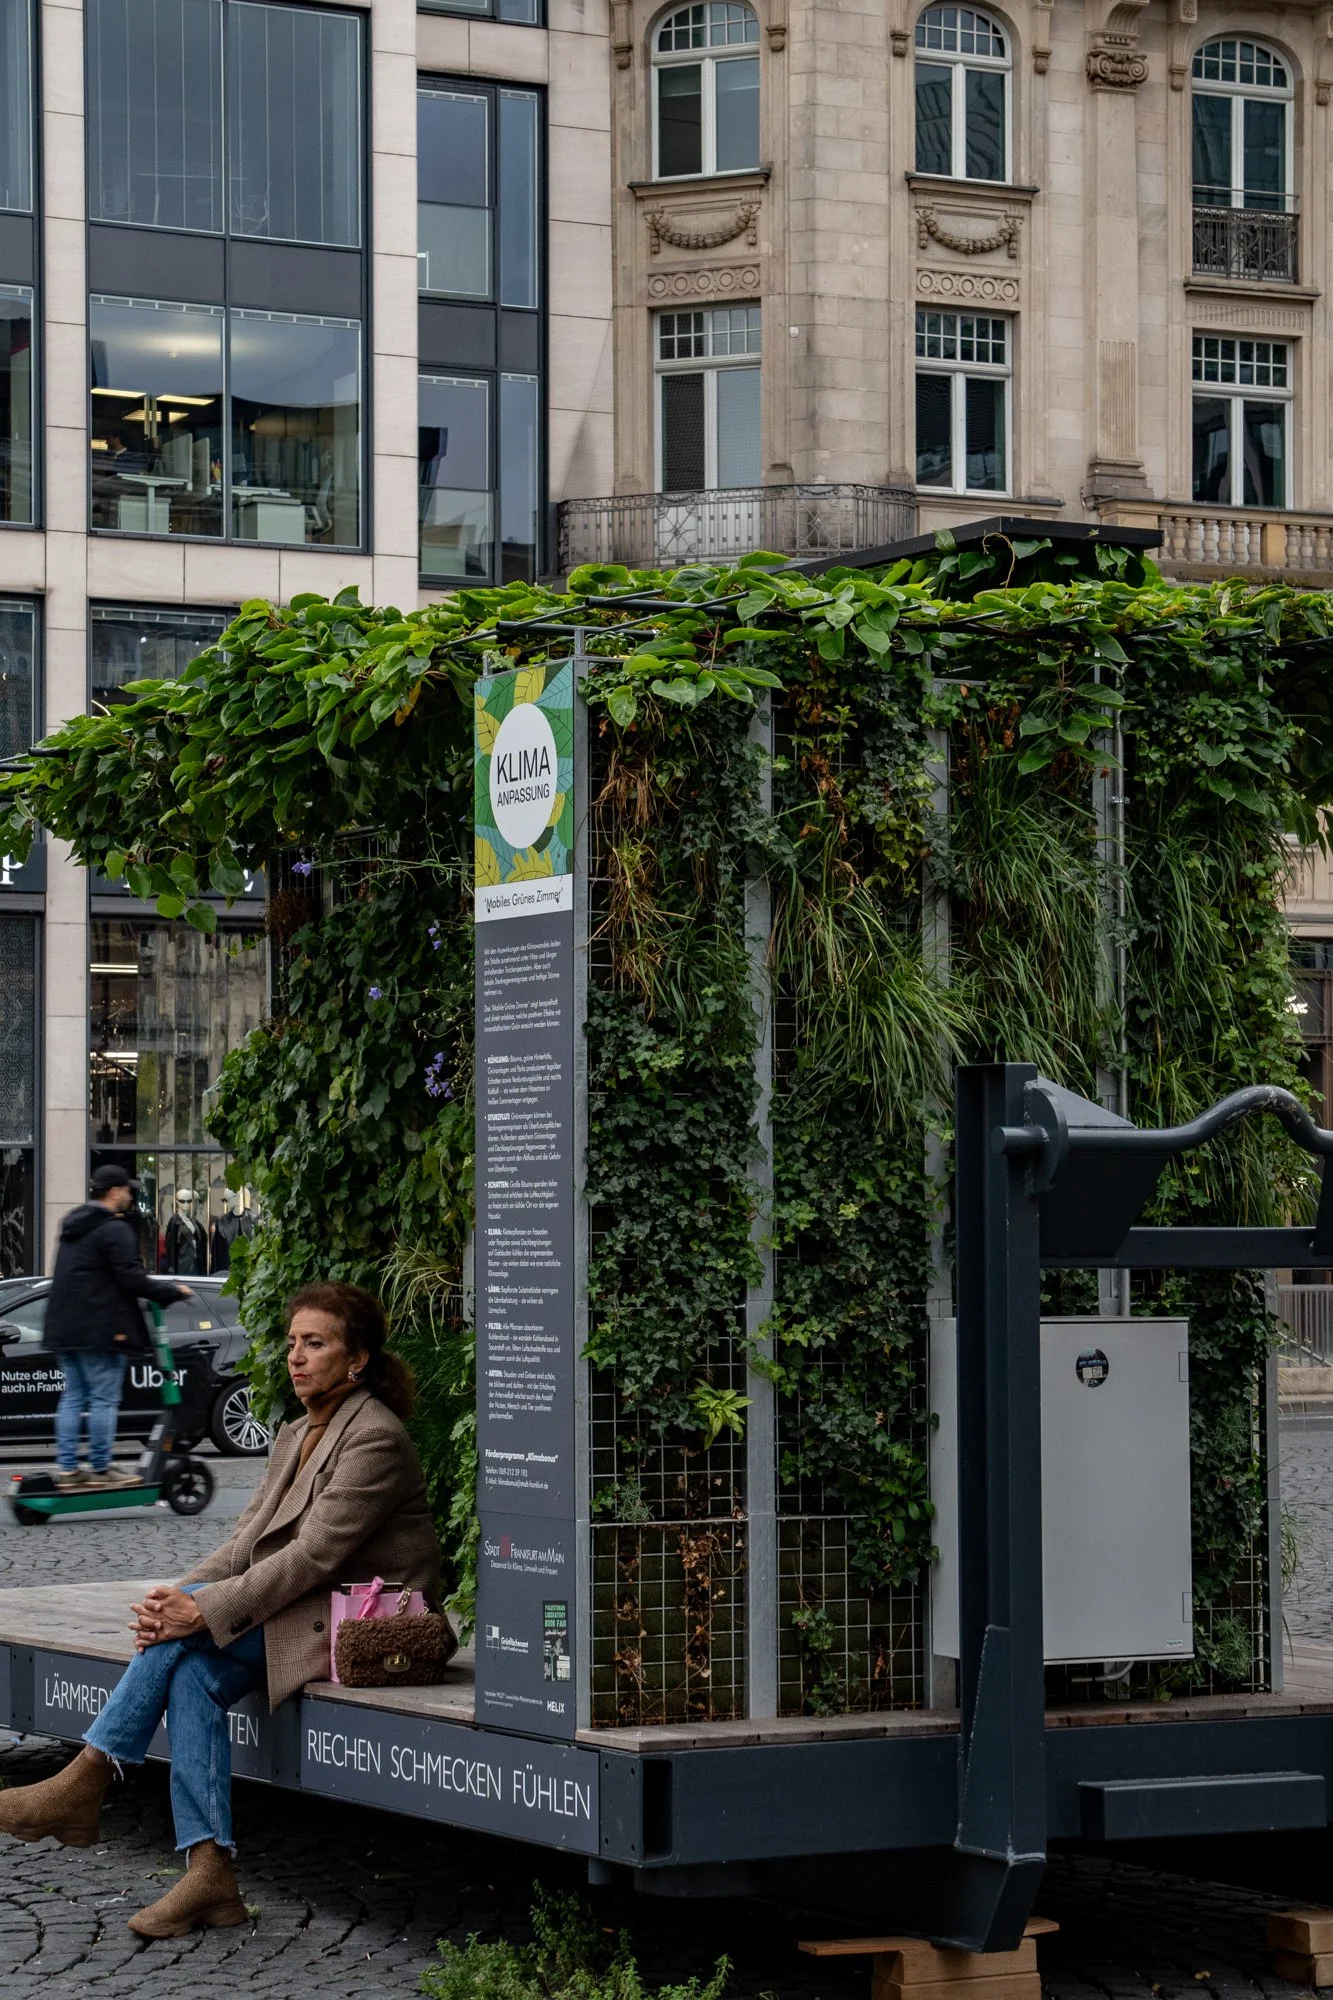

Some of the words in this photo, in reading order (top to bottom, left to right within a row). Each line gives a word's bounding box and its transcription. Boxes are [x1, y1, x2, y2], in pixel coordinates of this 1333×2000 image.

[497, 745, 551, 785] KLIMA
[497, 783, 550, 807] ANPASSUNG
[511, 889, 536, 906] Grünes
[1, 1370, 30, 1381] Nutze
[32, 1369, 48, 1380] die
[1, 1383, 25, 1393] auch
[27, 1382, 36, 1392] in
[37, 1381, 67, 1392] Frankf
[485, 1449, 524, 1461] Förderprogramm
[45, 1672, 110, 1717] LÄRMRED
[546, 1700, 564, 1713] HELIX
[308, 1729, 381, 1775] RIECHEN
[390, 1745, 502, 1801] SCHMECKEN
[513, 1764, 590, 1820] FÜHLEN
